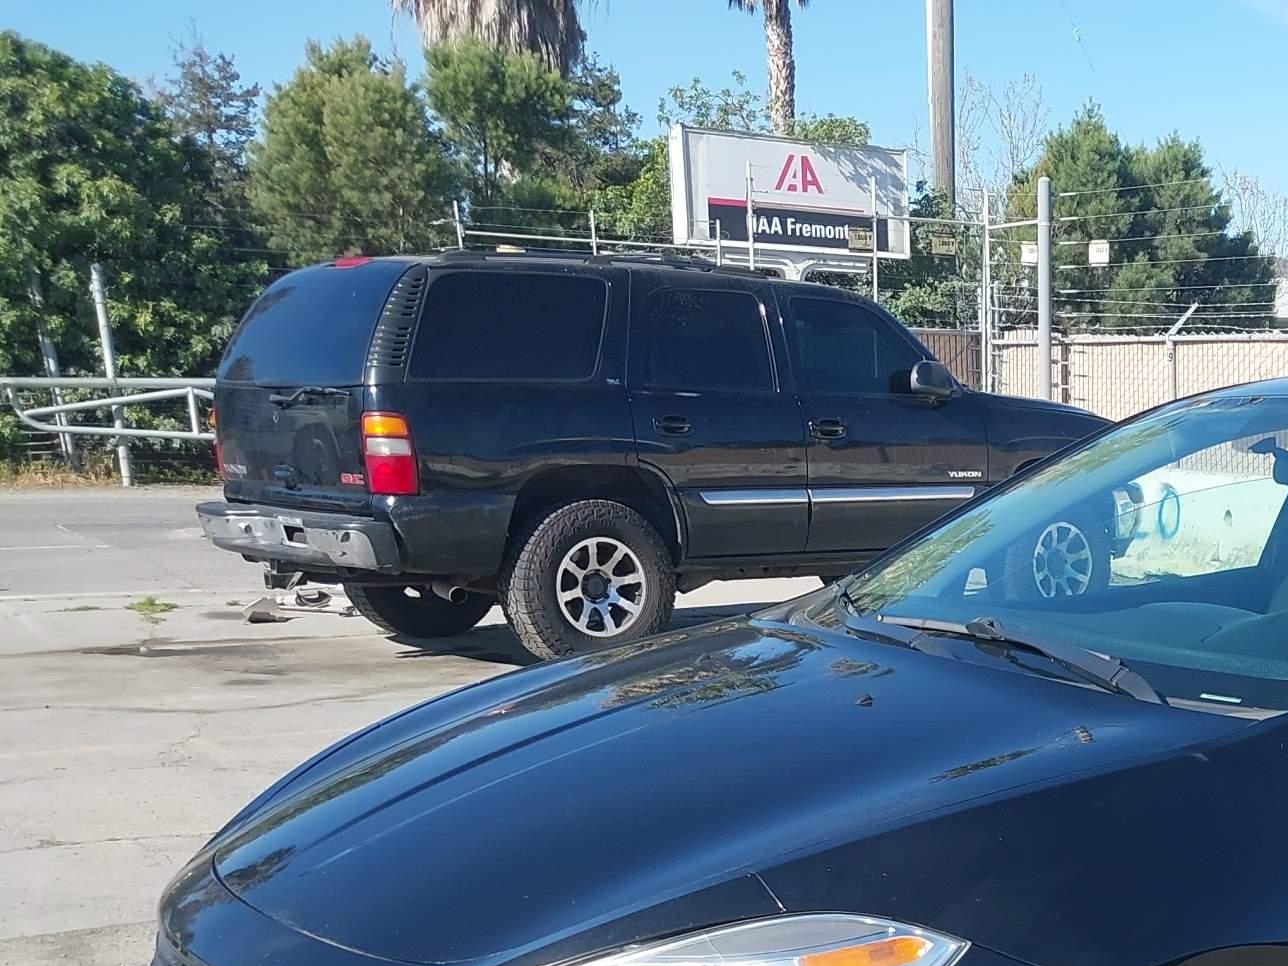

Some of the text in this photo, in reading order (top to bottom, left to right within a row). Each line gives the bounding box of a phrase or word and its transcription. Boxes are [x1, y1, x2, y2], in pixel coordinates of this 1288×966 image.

[752, 214, 850, 240] IAA Fremont
[947, 470, 982, 478] YUKON
